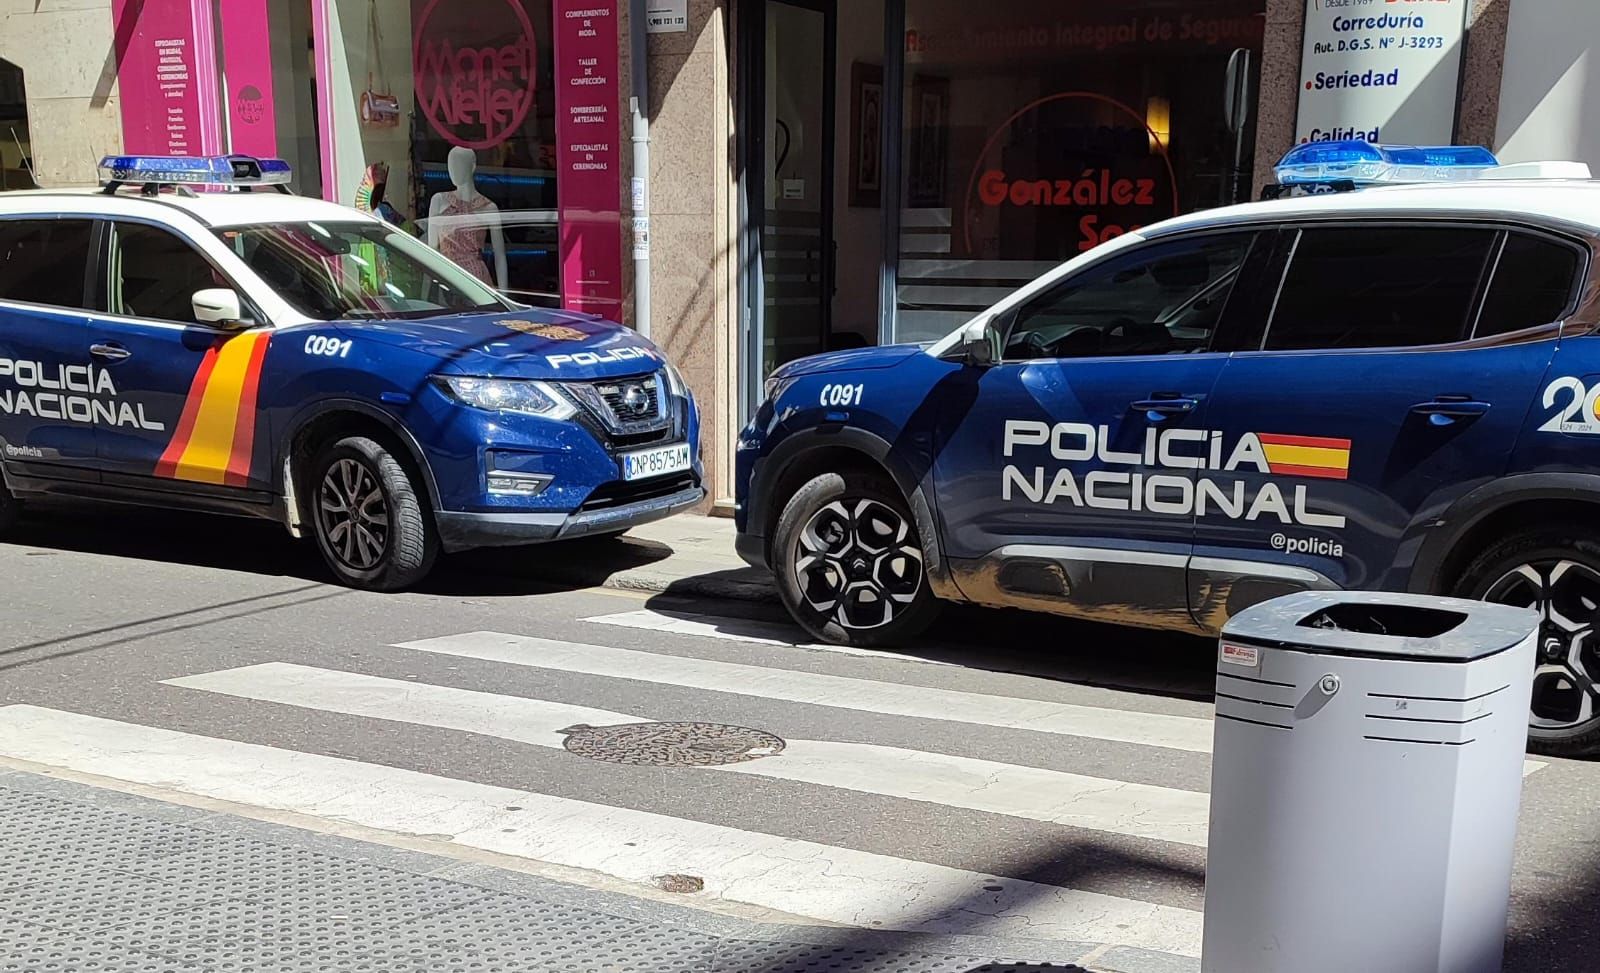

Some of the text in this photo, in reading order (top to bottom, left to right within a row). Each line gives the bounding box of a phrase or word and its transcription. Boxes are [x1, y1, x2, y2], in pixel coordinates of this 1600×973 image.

[565, 8, 609, 18] COMPLEMENTOS
[1332, 11, 1424, 32] Correduría
[579, 29, 596, 37] MODA
[1056, 17, 1137, 47] Integral
[1144, 16, 1173, 41] de
[1314, 42, 1334, 54] Aut.
[1337, 38, 1374, 52] D.G.S.
[1398, 36, 1443, 49] J-3293
[571, 77, 606, 85] CONFECCIÓN
[1314, 69, 1399, 90] Seriedad
[573, 115, 604, 123] ARTESANAL
[1310, 126, 1379, 143] Calidad
[570, 143, 608, 151] ESPECIALISTAS
[978, 169, 1154, 206] González
[0, 389, 165, 432] NACIONAL
[1002, 464, 1346, 529] NACIONAL
[1270, 532, 1344, 558] @policia
